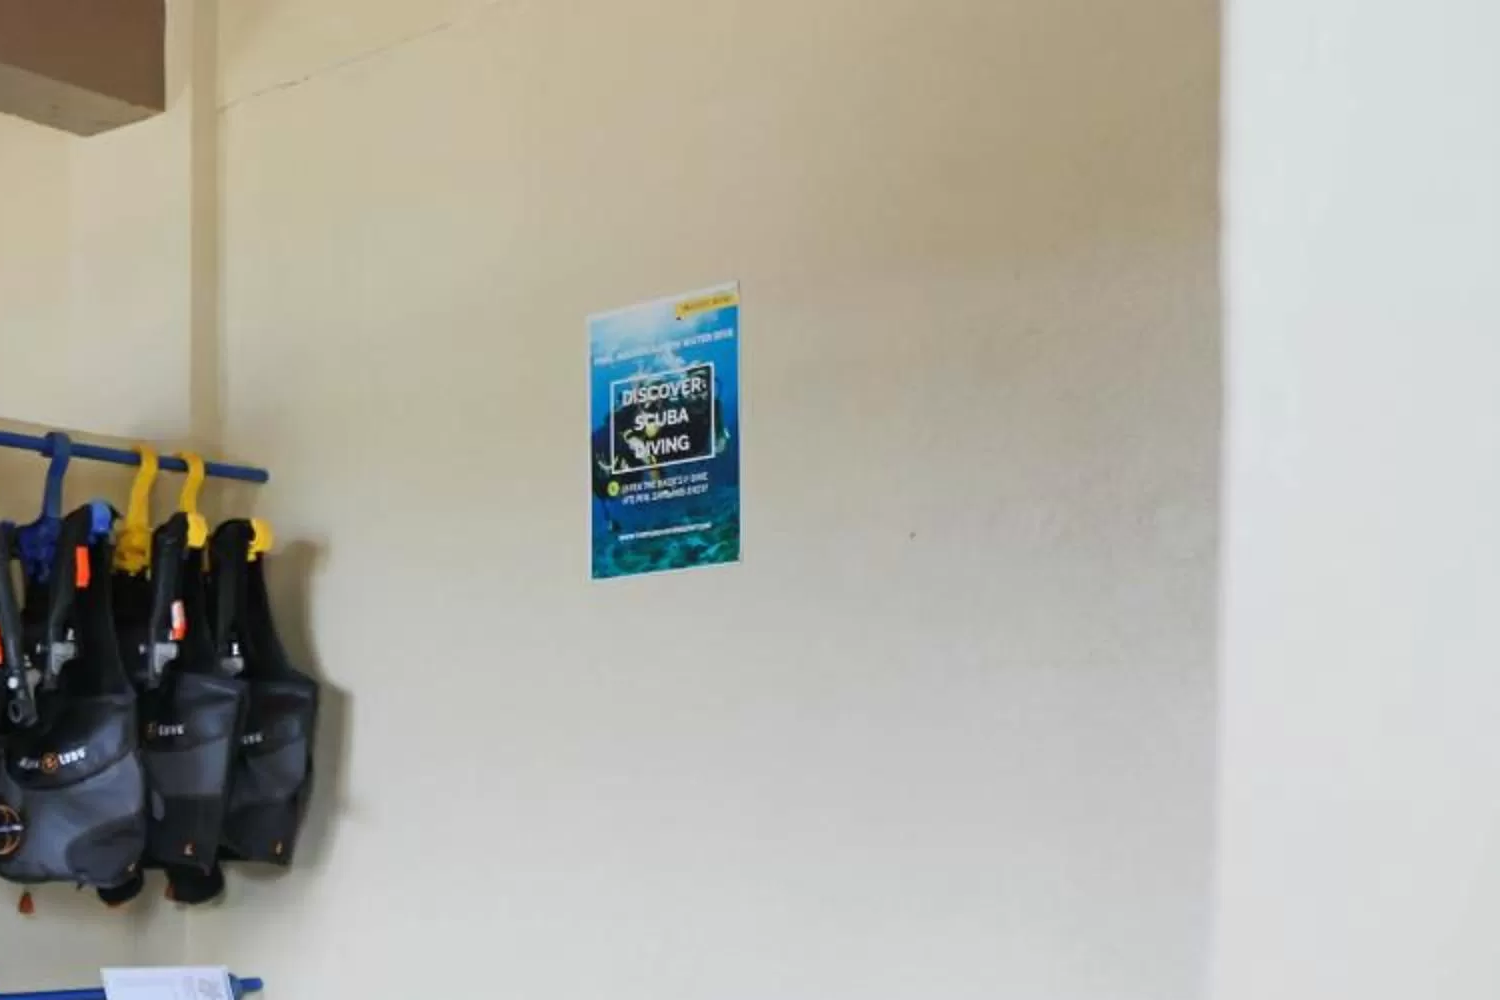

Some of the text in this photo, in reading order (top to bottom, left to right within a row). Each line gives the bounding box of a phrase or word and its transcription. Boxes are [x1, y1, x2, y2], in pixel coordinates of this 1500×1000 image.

[622, 377, 703, 406] DISCOVER
[634, 407, 690, 431] SCUBA
[635, 435, 691, 459] DIVING
